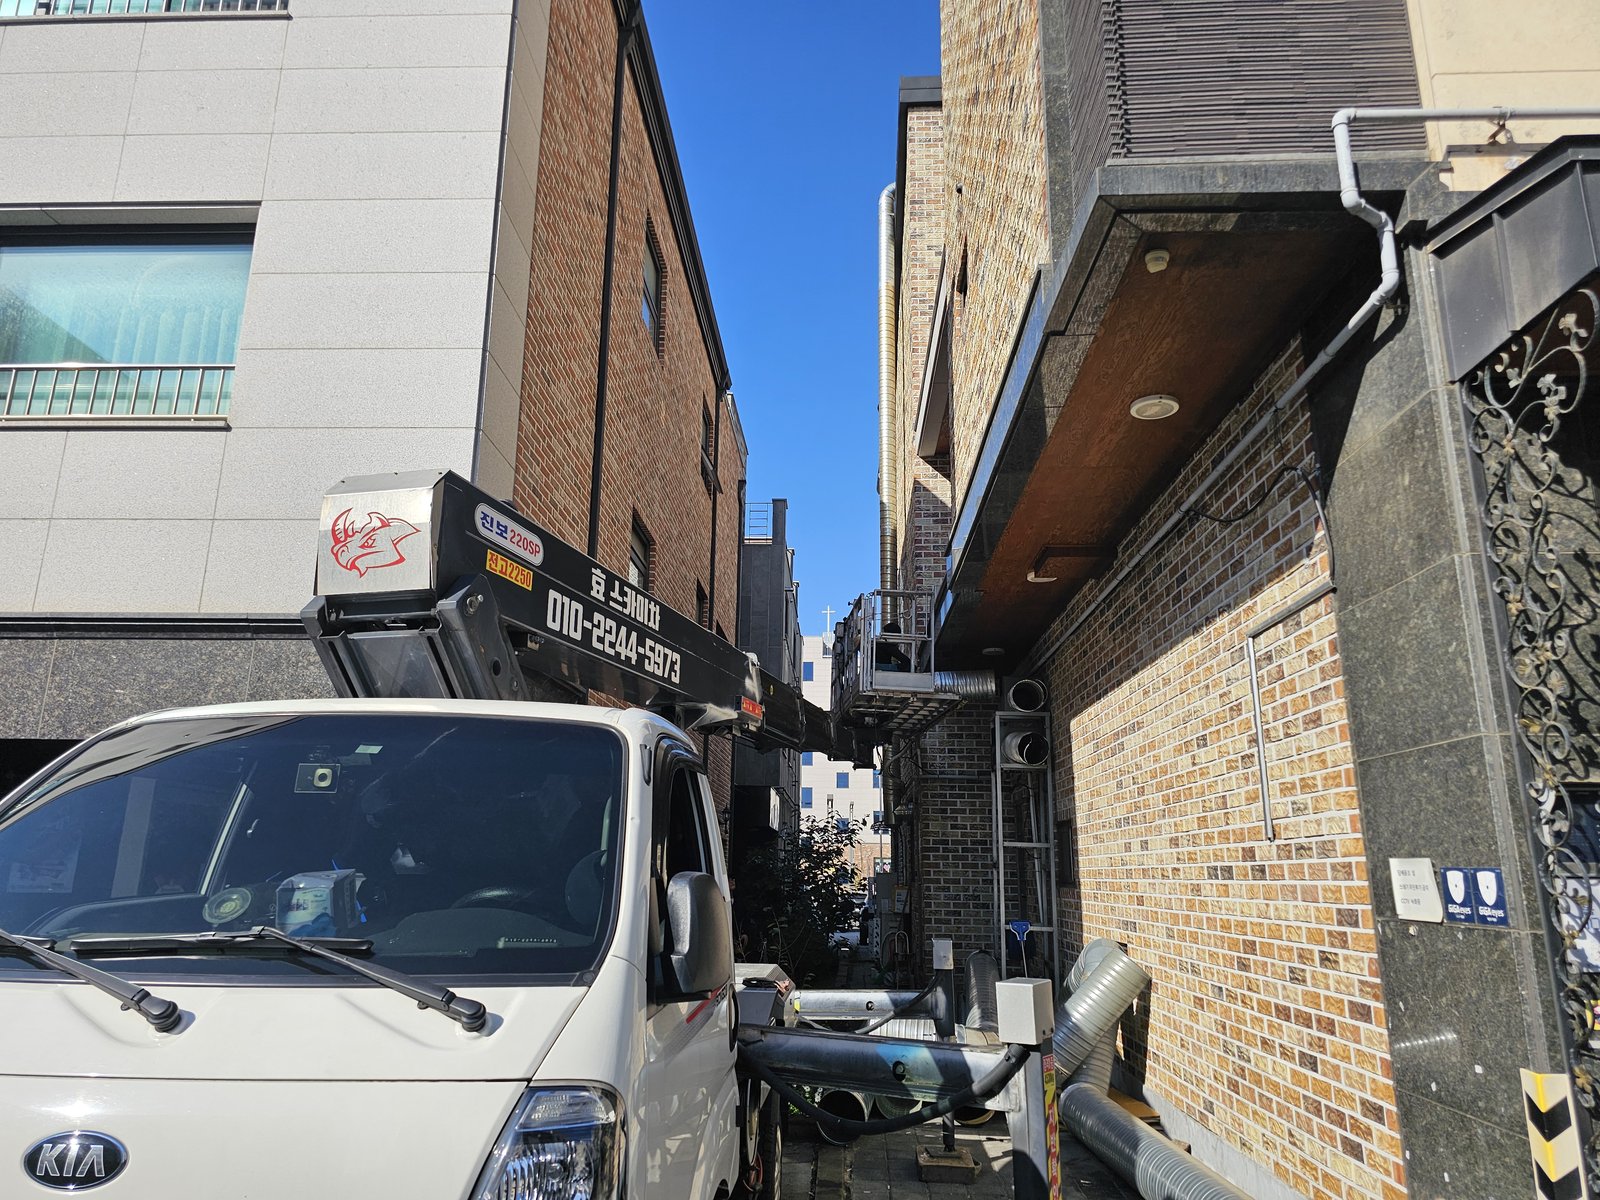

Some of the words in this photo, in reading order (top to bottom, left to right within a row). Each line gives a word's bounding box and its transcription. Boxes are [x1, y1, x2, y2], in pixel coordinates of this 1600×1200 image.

[480, 510, 508, 540] 진보
[509, 528, 541, 558] 220SP
[488, 551, 532, 589] 전고2250
[590, 567, 607, 602] 효
[609, 580, 661, 632] 스카이차
[546, 588, 681, 684] 010-2244-5973
[36, 1143, 105, 1178] KIA
